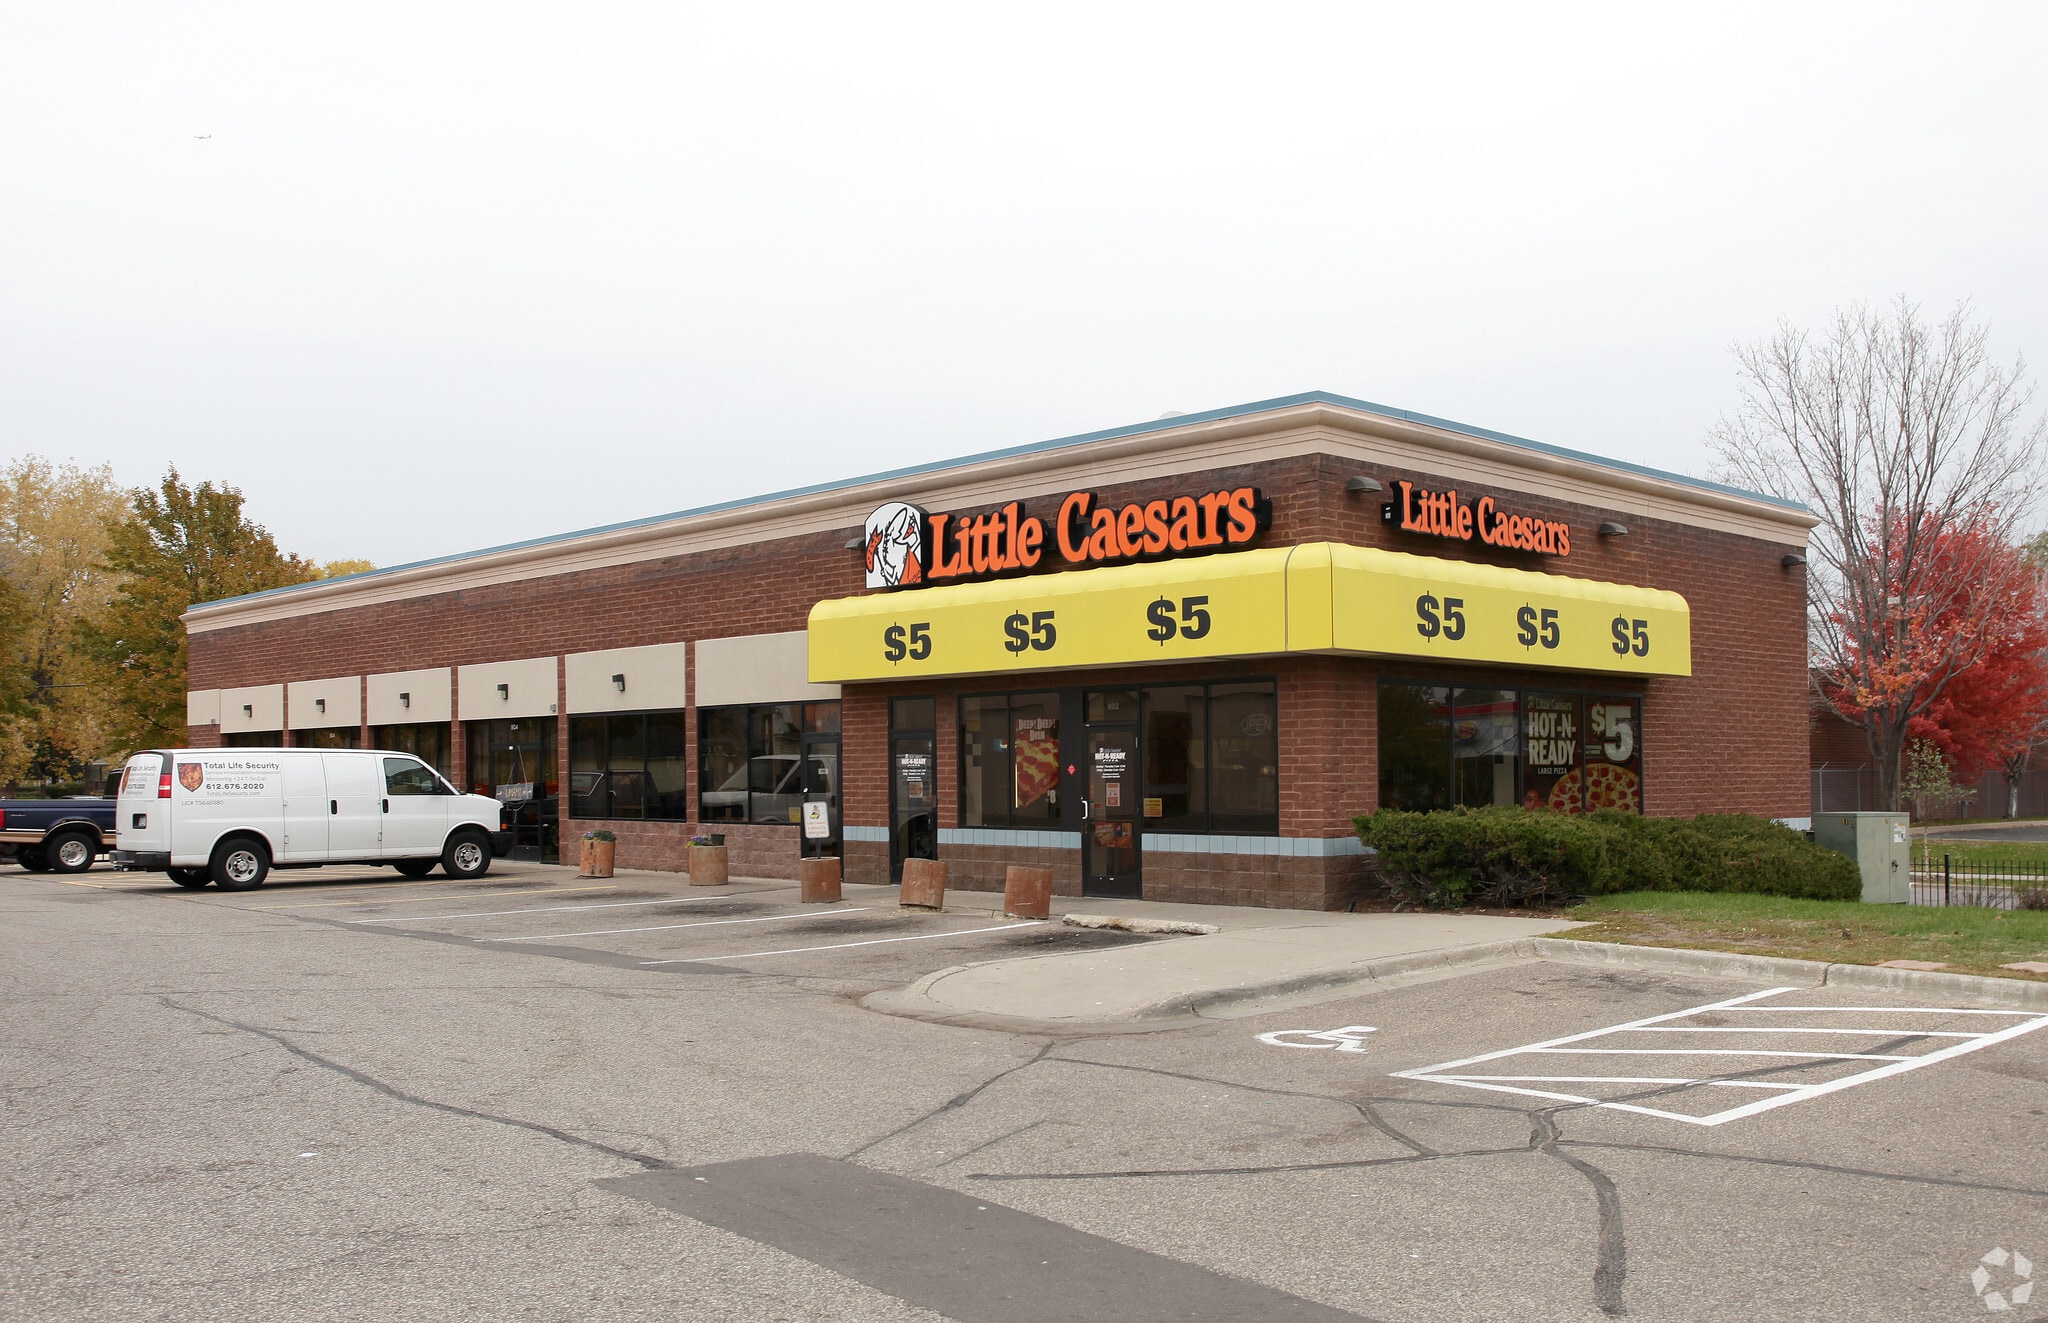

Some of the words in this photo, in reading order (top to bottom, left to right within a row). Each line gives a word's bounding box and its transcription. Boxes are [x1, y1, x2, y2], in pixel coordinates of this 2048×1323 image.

[927, 502, 1042, 579] Little
[1056, 487, 1258, 563] Caesars
[1399, 481, 1472, 540] Little
[1477, 496, 1571, 557] Caesars
[1004, 609, 1057, 657] $5
[1147, 595, 1212, 647] $5
[1416, 590, 1466, 643] $5
[1517, 602, 1560, 651] $5
[1611, 613, 1650, 660] $5
[884, 622, 932, 666] $5
[1107, 702, 1119, 710] 902
[1241, 718, 1272, 731] OPEN
[1528, 711, 1577, 738] HOT-N-
[1528, 739, 1576, 765] READY
[1591, 702, 1633, 762] $5
[245, 762, 280, 770] Security
[1538, 767, 1553, 775] LARGE
